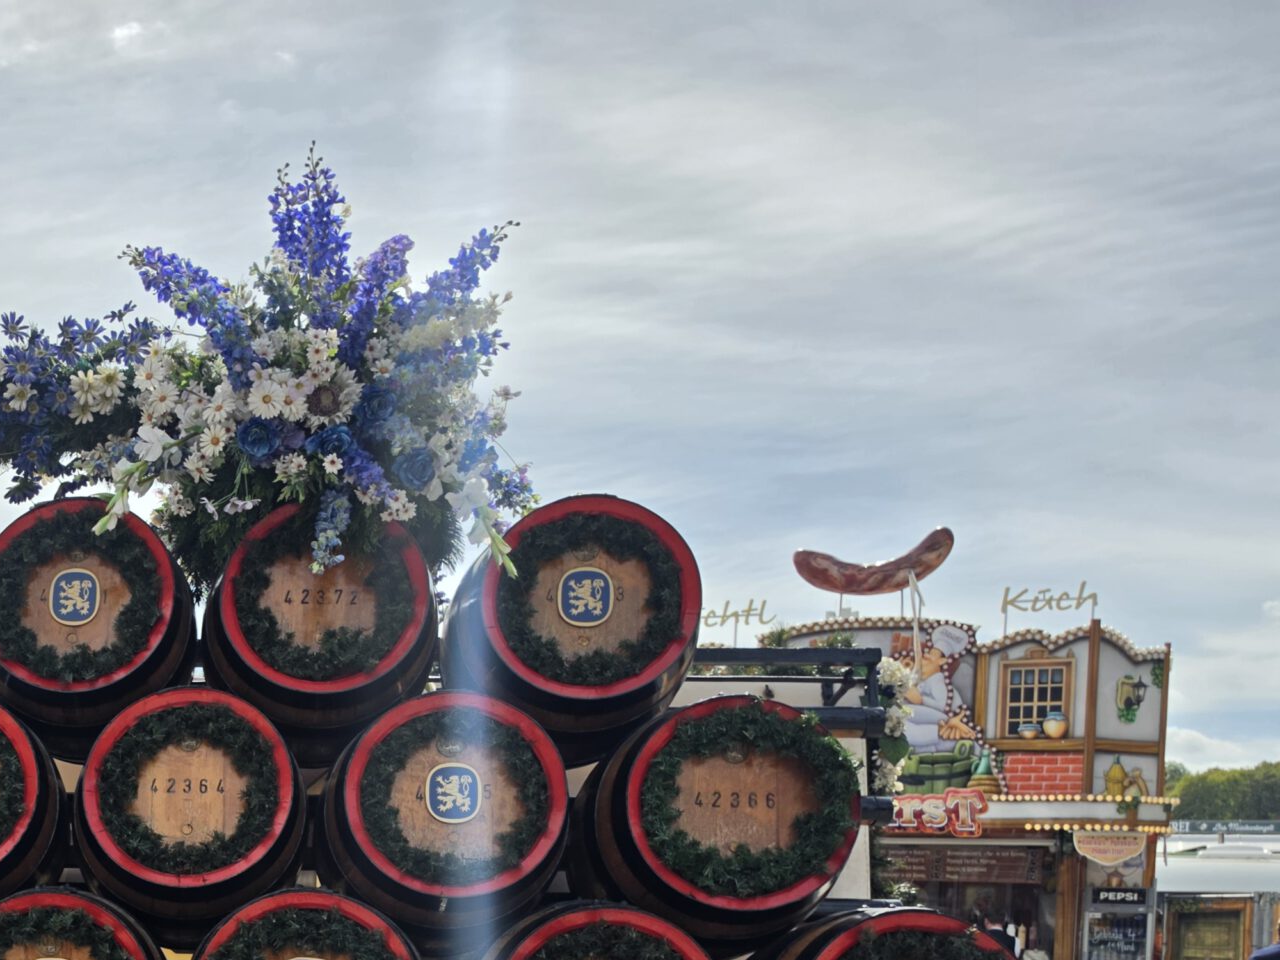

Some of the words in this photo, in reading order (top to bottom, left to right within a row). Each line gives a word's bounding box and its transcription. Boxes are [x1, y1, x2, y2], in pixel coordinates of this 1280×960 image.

[284, 588, 359, 605] 42372
[150, 777, 225, 794] 42364
[694, 791, 776, 809] 42366
[1171, 821, 1190, 833] REI
[1099, 892, 1138, 901] PEPSI
